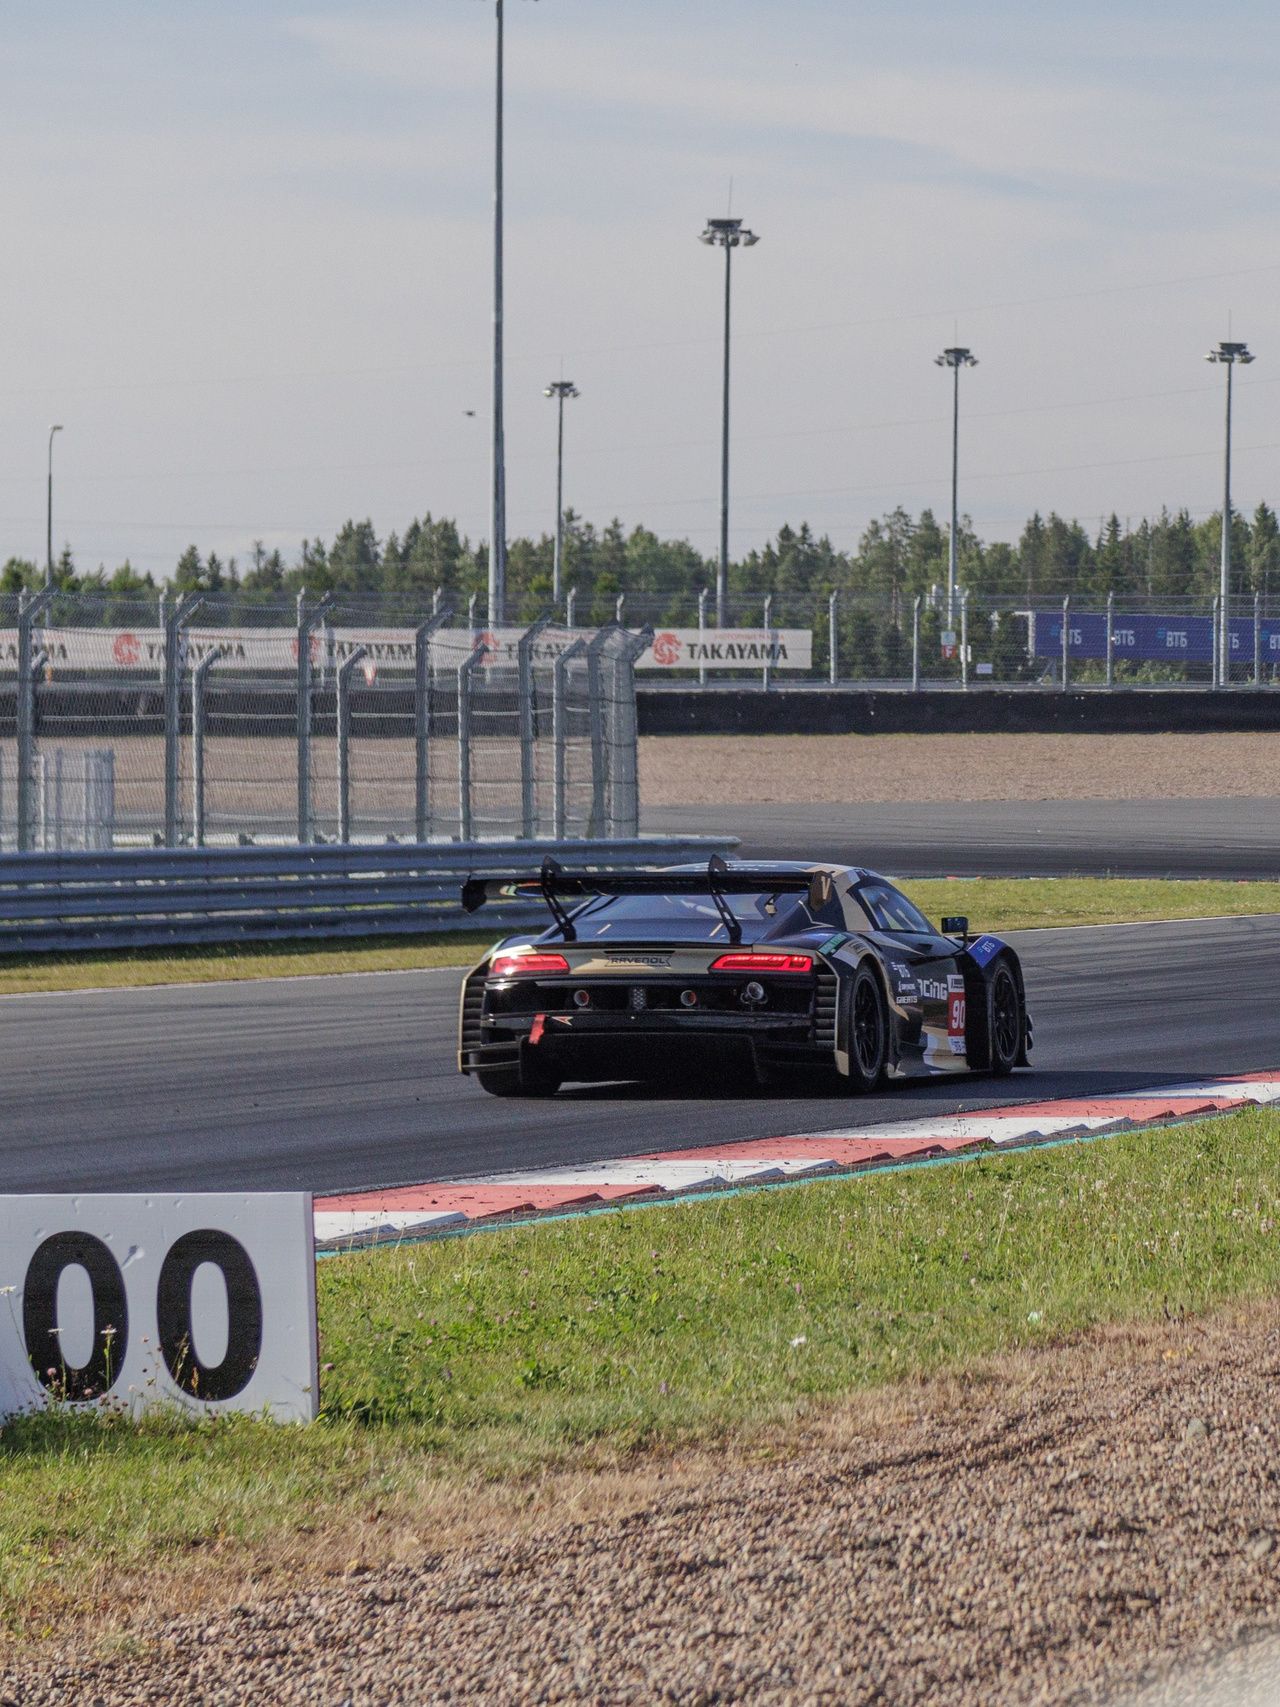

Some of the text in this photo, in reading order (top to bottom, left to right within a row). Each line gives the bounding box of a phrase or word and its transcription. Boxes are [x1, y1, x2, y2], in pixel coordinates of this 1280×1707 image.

[1113, 630, 1135, 646] ВТБ
[1166, 631, 1188, 648] ВТБ
[686, 643, 788, 660] TAKAYAMA
[951, 1000, 966, 1029] 90
[23, 1228, 263, 1402] 00
